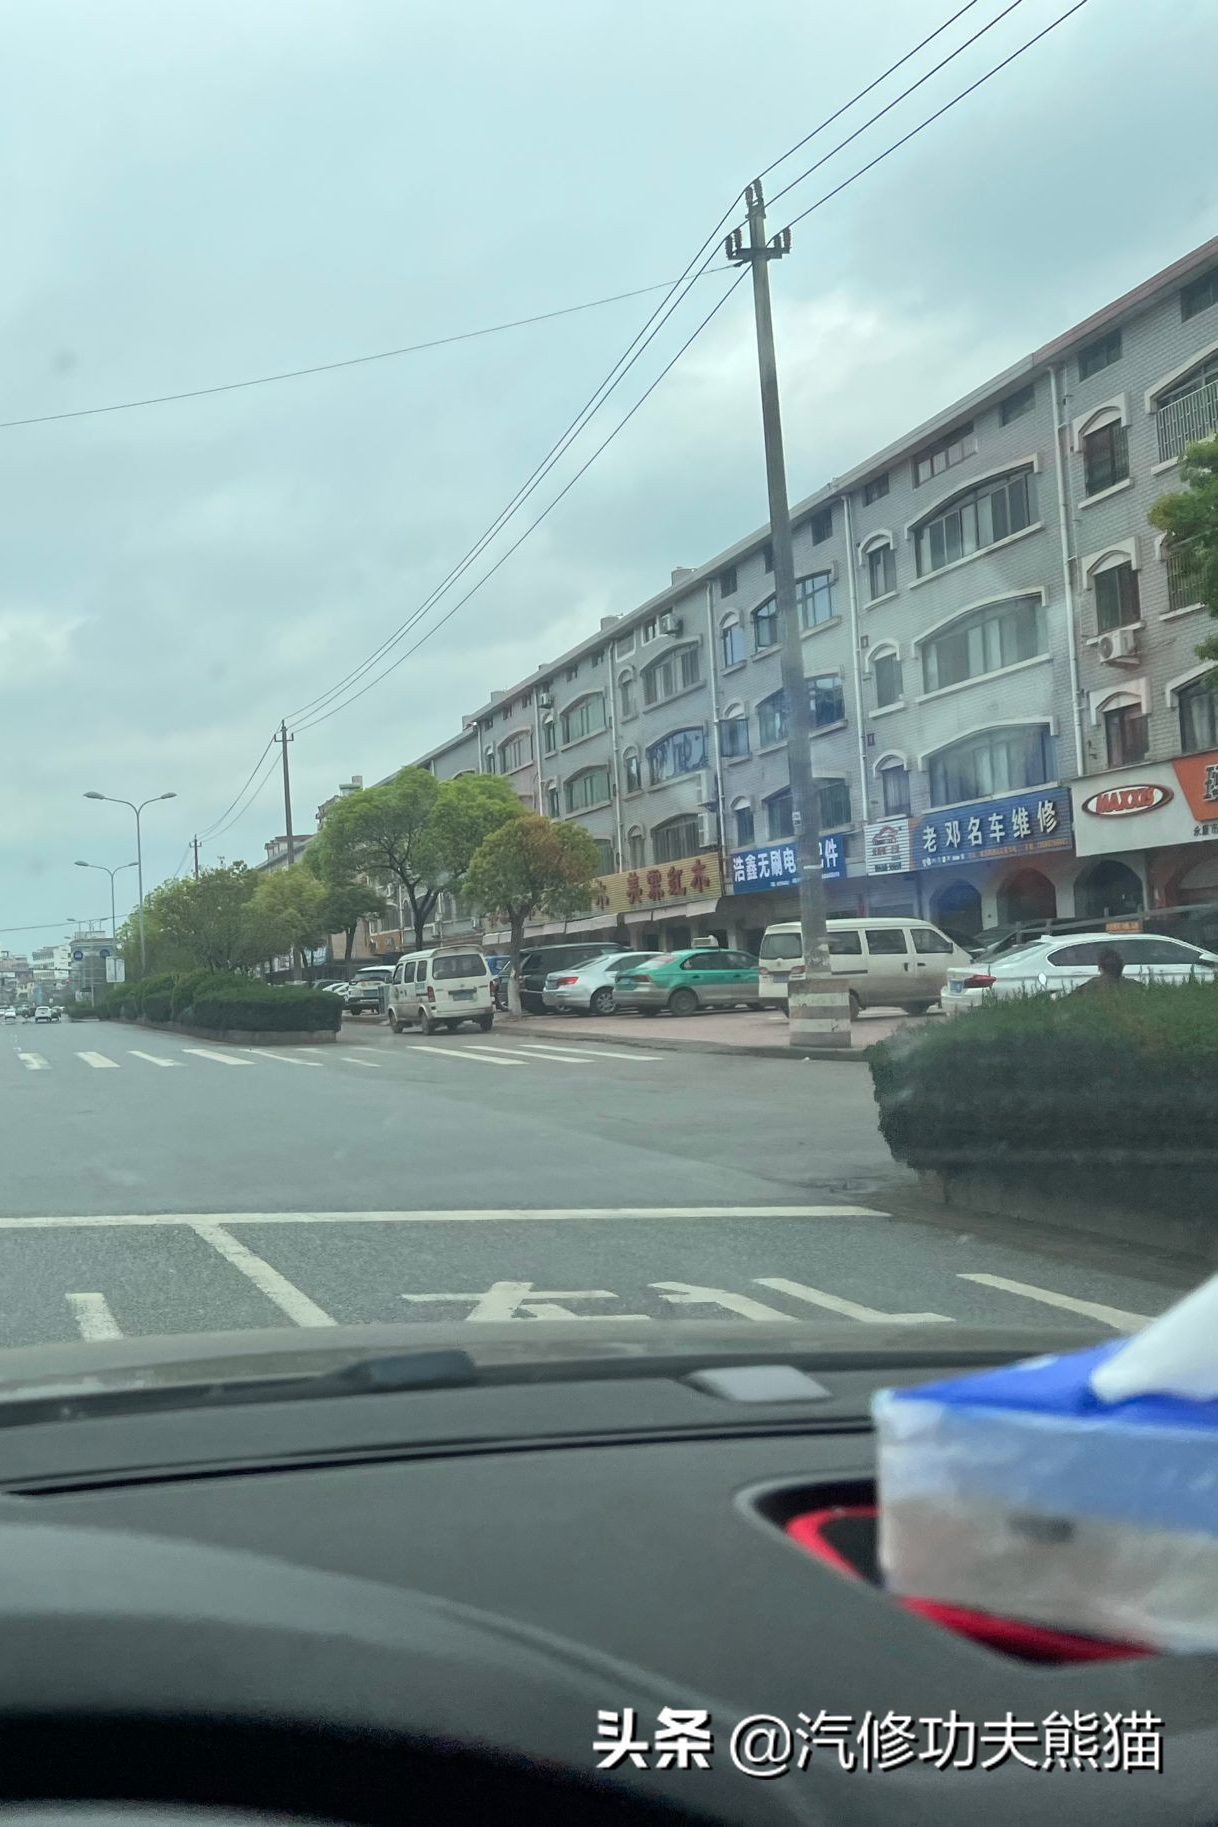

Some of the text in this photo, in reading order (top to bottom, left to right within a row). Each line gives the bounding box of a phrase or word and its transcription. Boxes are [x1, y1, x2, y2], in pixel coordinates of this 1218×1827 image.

[922, 800, 1057, 853] 老邓名车维修
